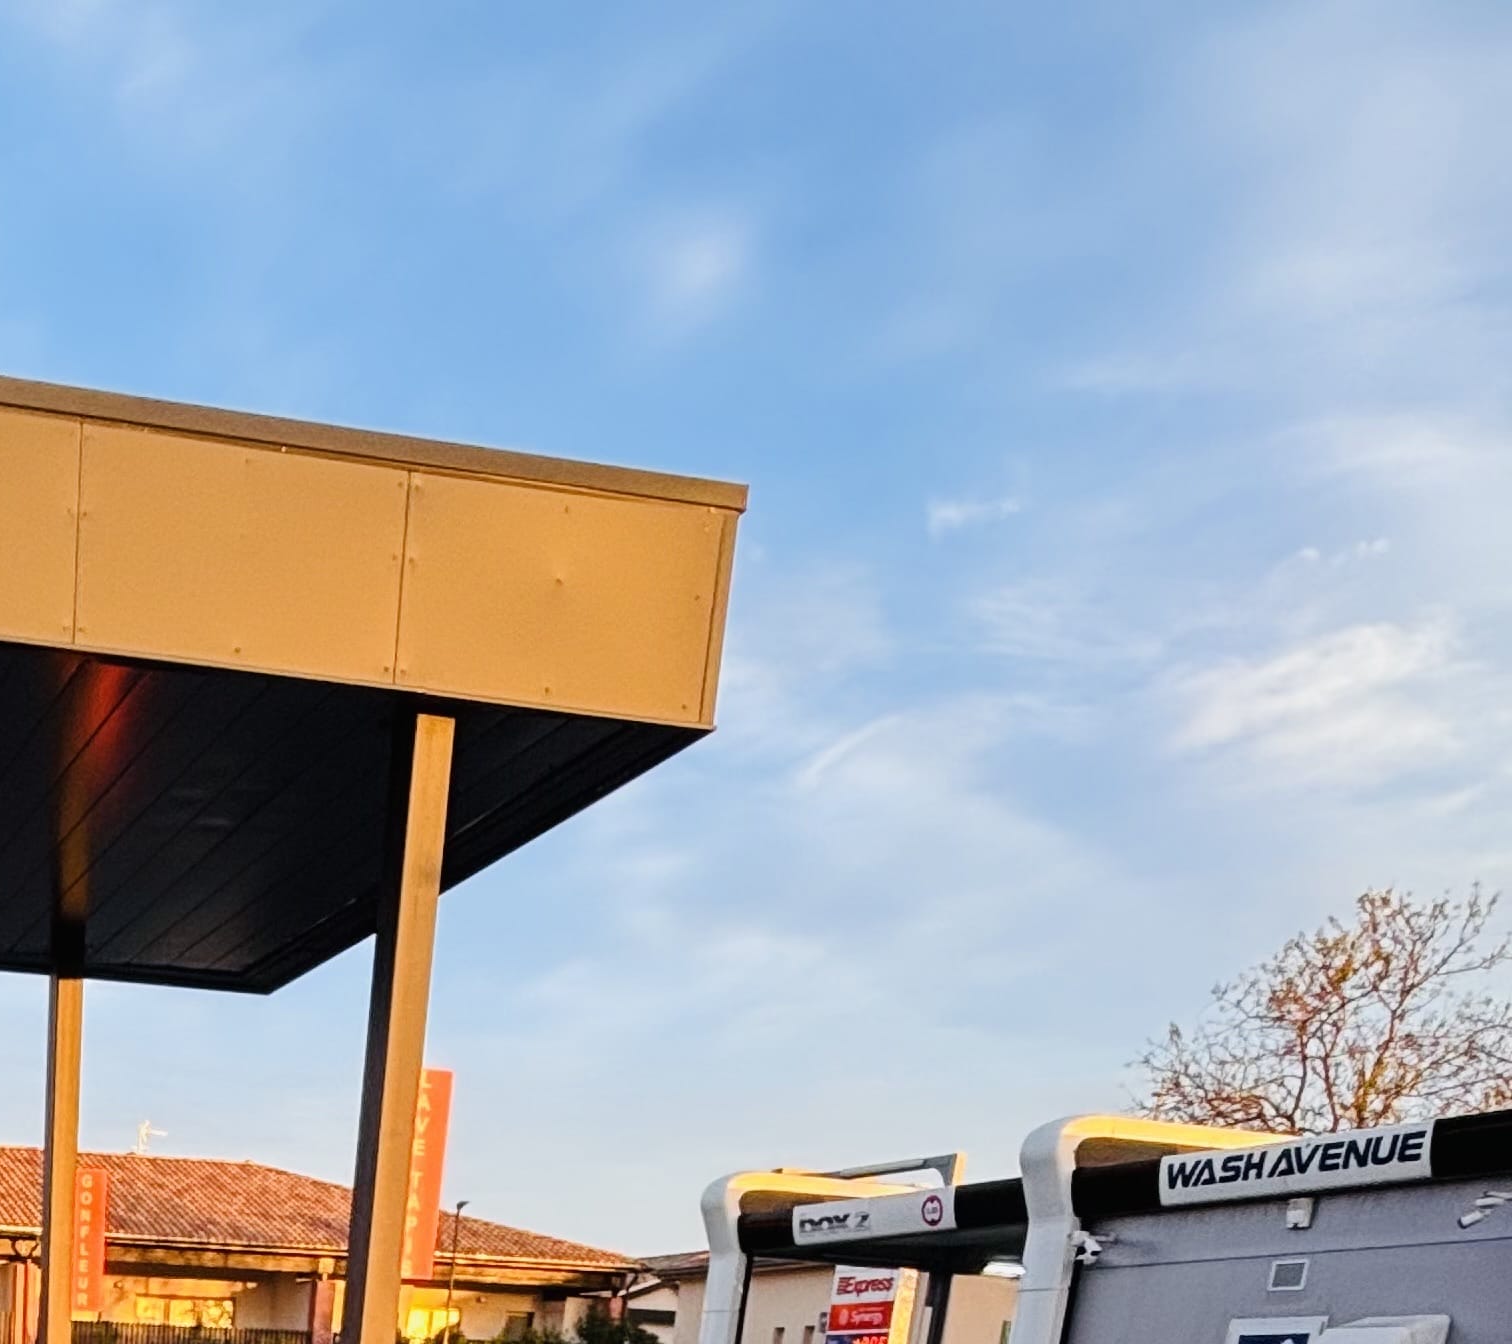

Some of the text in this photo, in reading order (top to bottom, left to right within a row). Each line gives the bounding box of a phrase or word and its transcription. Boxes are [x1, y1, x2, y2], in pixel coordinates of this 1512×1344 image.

[413, 1069, 433, 1156] LAVE
[1167, 1129, 1428, 1190] WASH AVENUE
[76, 1173, 93, 1306] GONFLEUR
[836, 1276, 895, 1297] Express
